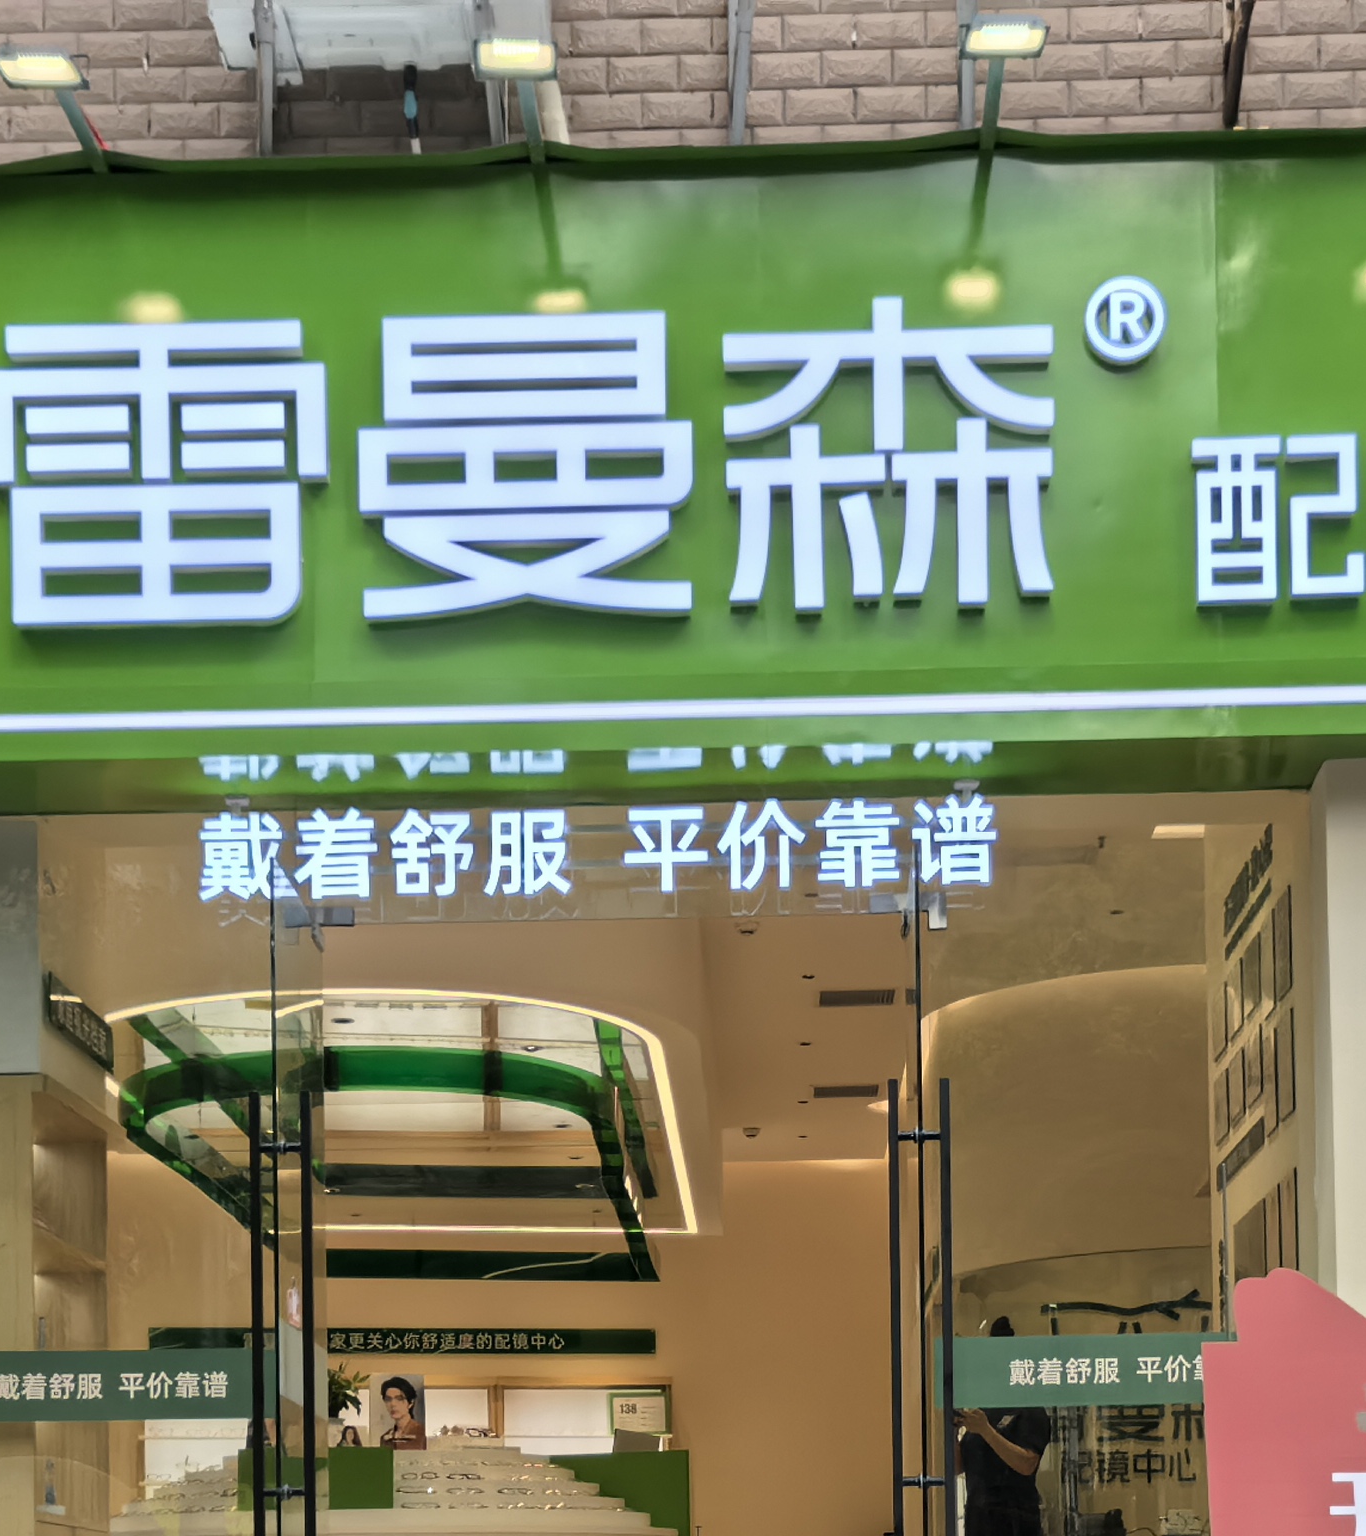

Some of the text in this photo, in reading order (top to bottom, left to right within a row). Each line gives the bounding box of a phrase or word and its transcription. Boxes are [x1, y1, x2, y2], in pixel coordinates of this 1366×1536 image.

[198, 795, 999, 903] 戴着舒服 平价靠谱
[119, 1370, 229, 1399] 平价靠谱
[1009, 1357, 1121, 1387] 戴着舒服
